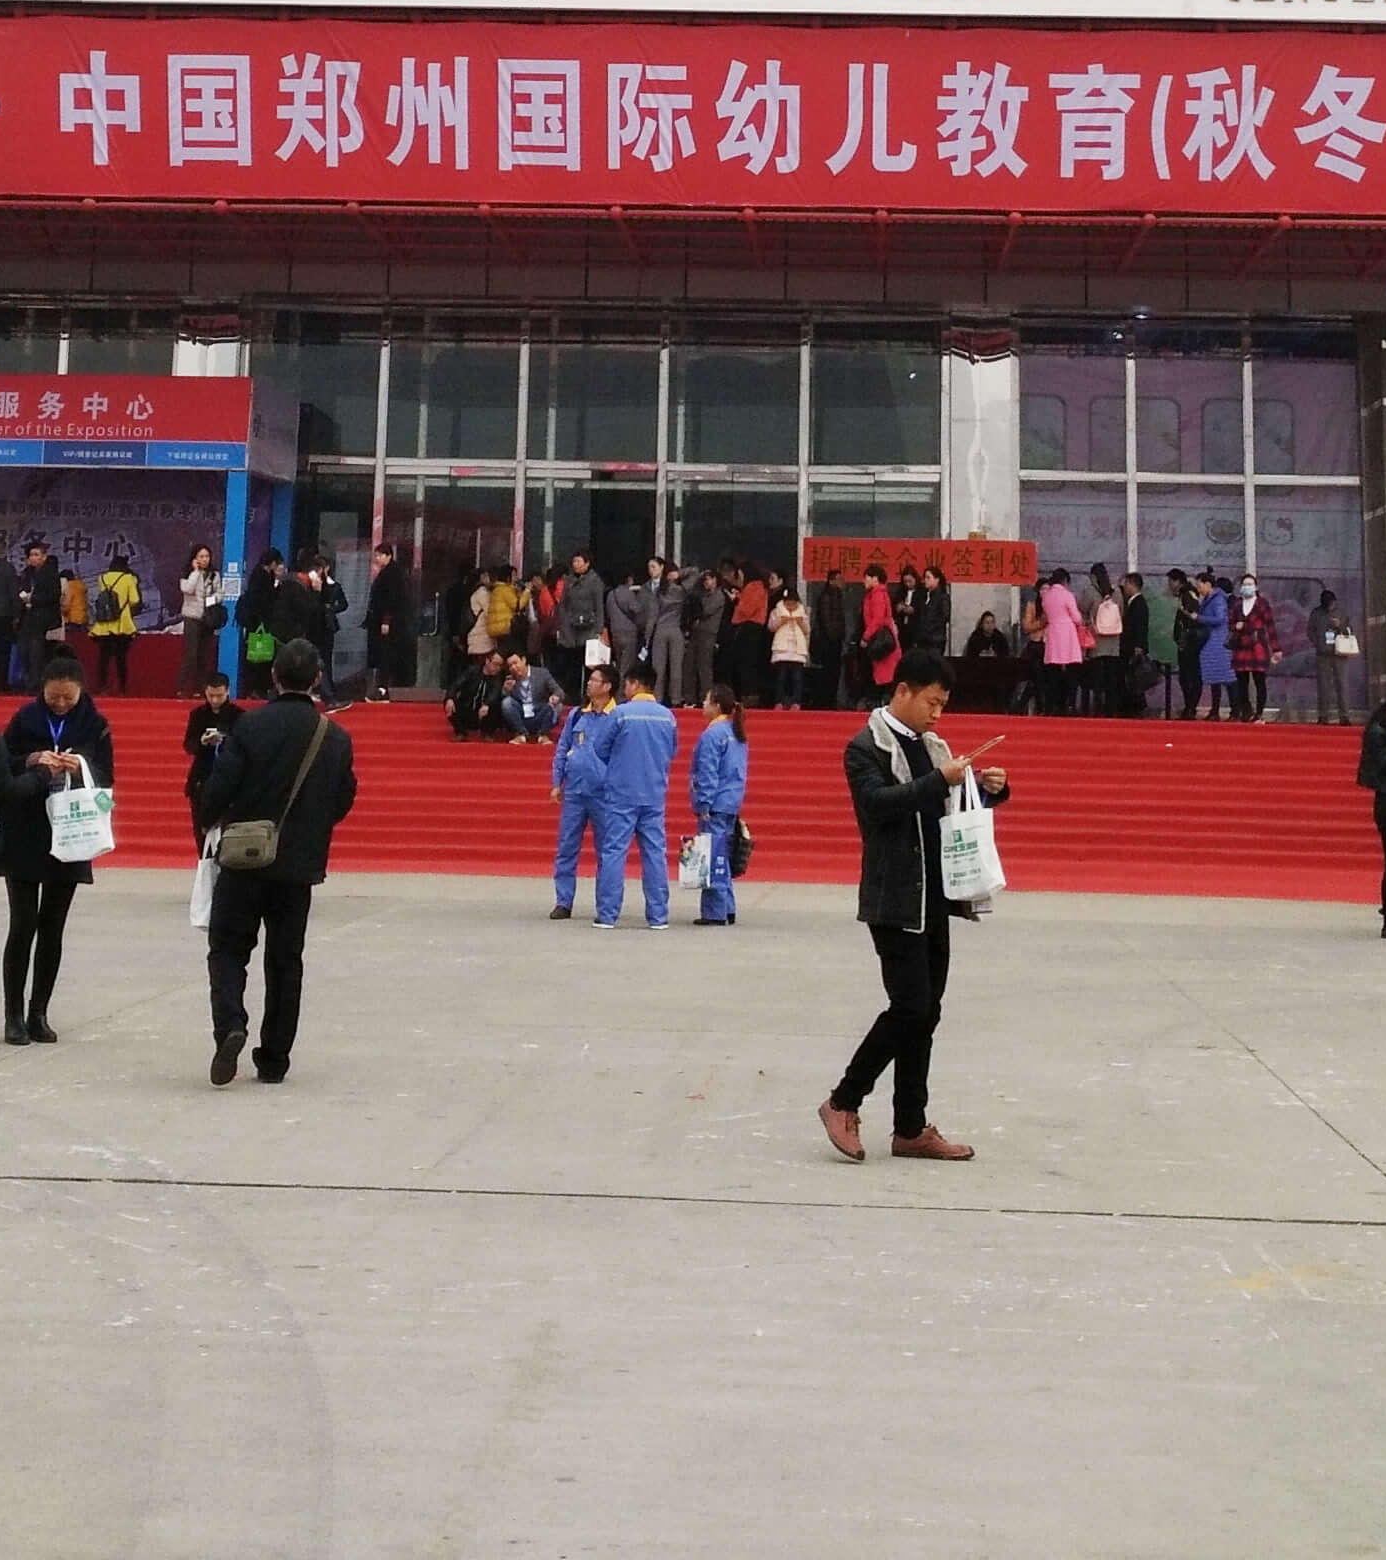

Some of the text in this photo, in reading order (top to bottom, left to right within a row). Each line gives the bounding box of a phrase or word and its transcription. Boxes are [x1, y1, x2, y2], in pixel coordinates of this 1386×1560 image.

[16, 422, 33, 436] of
[37, 423, 62, 436] the
[67, 424, 153, 439] Exposition
